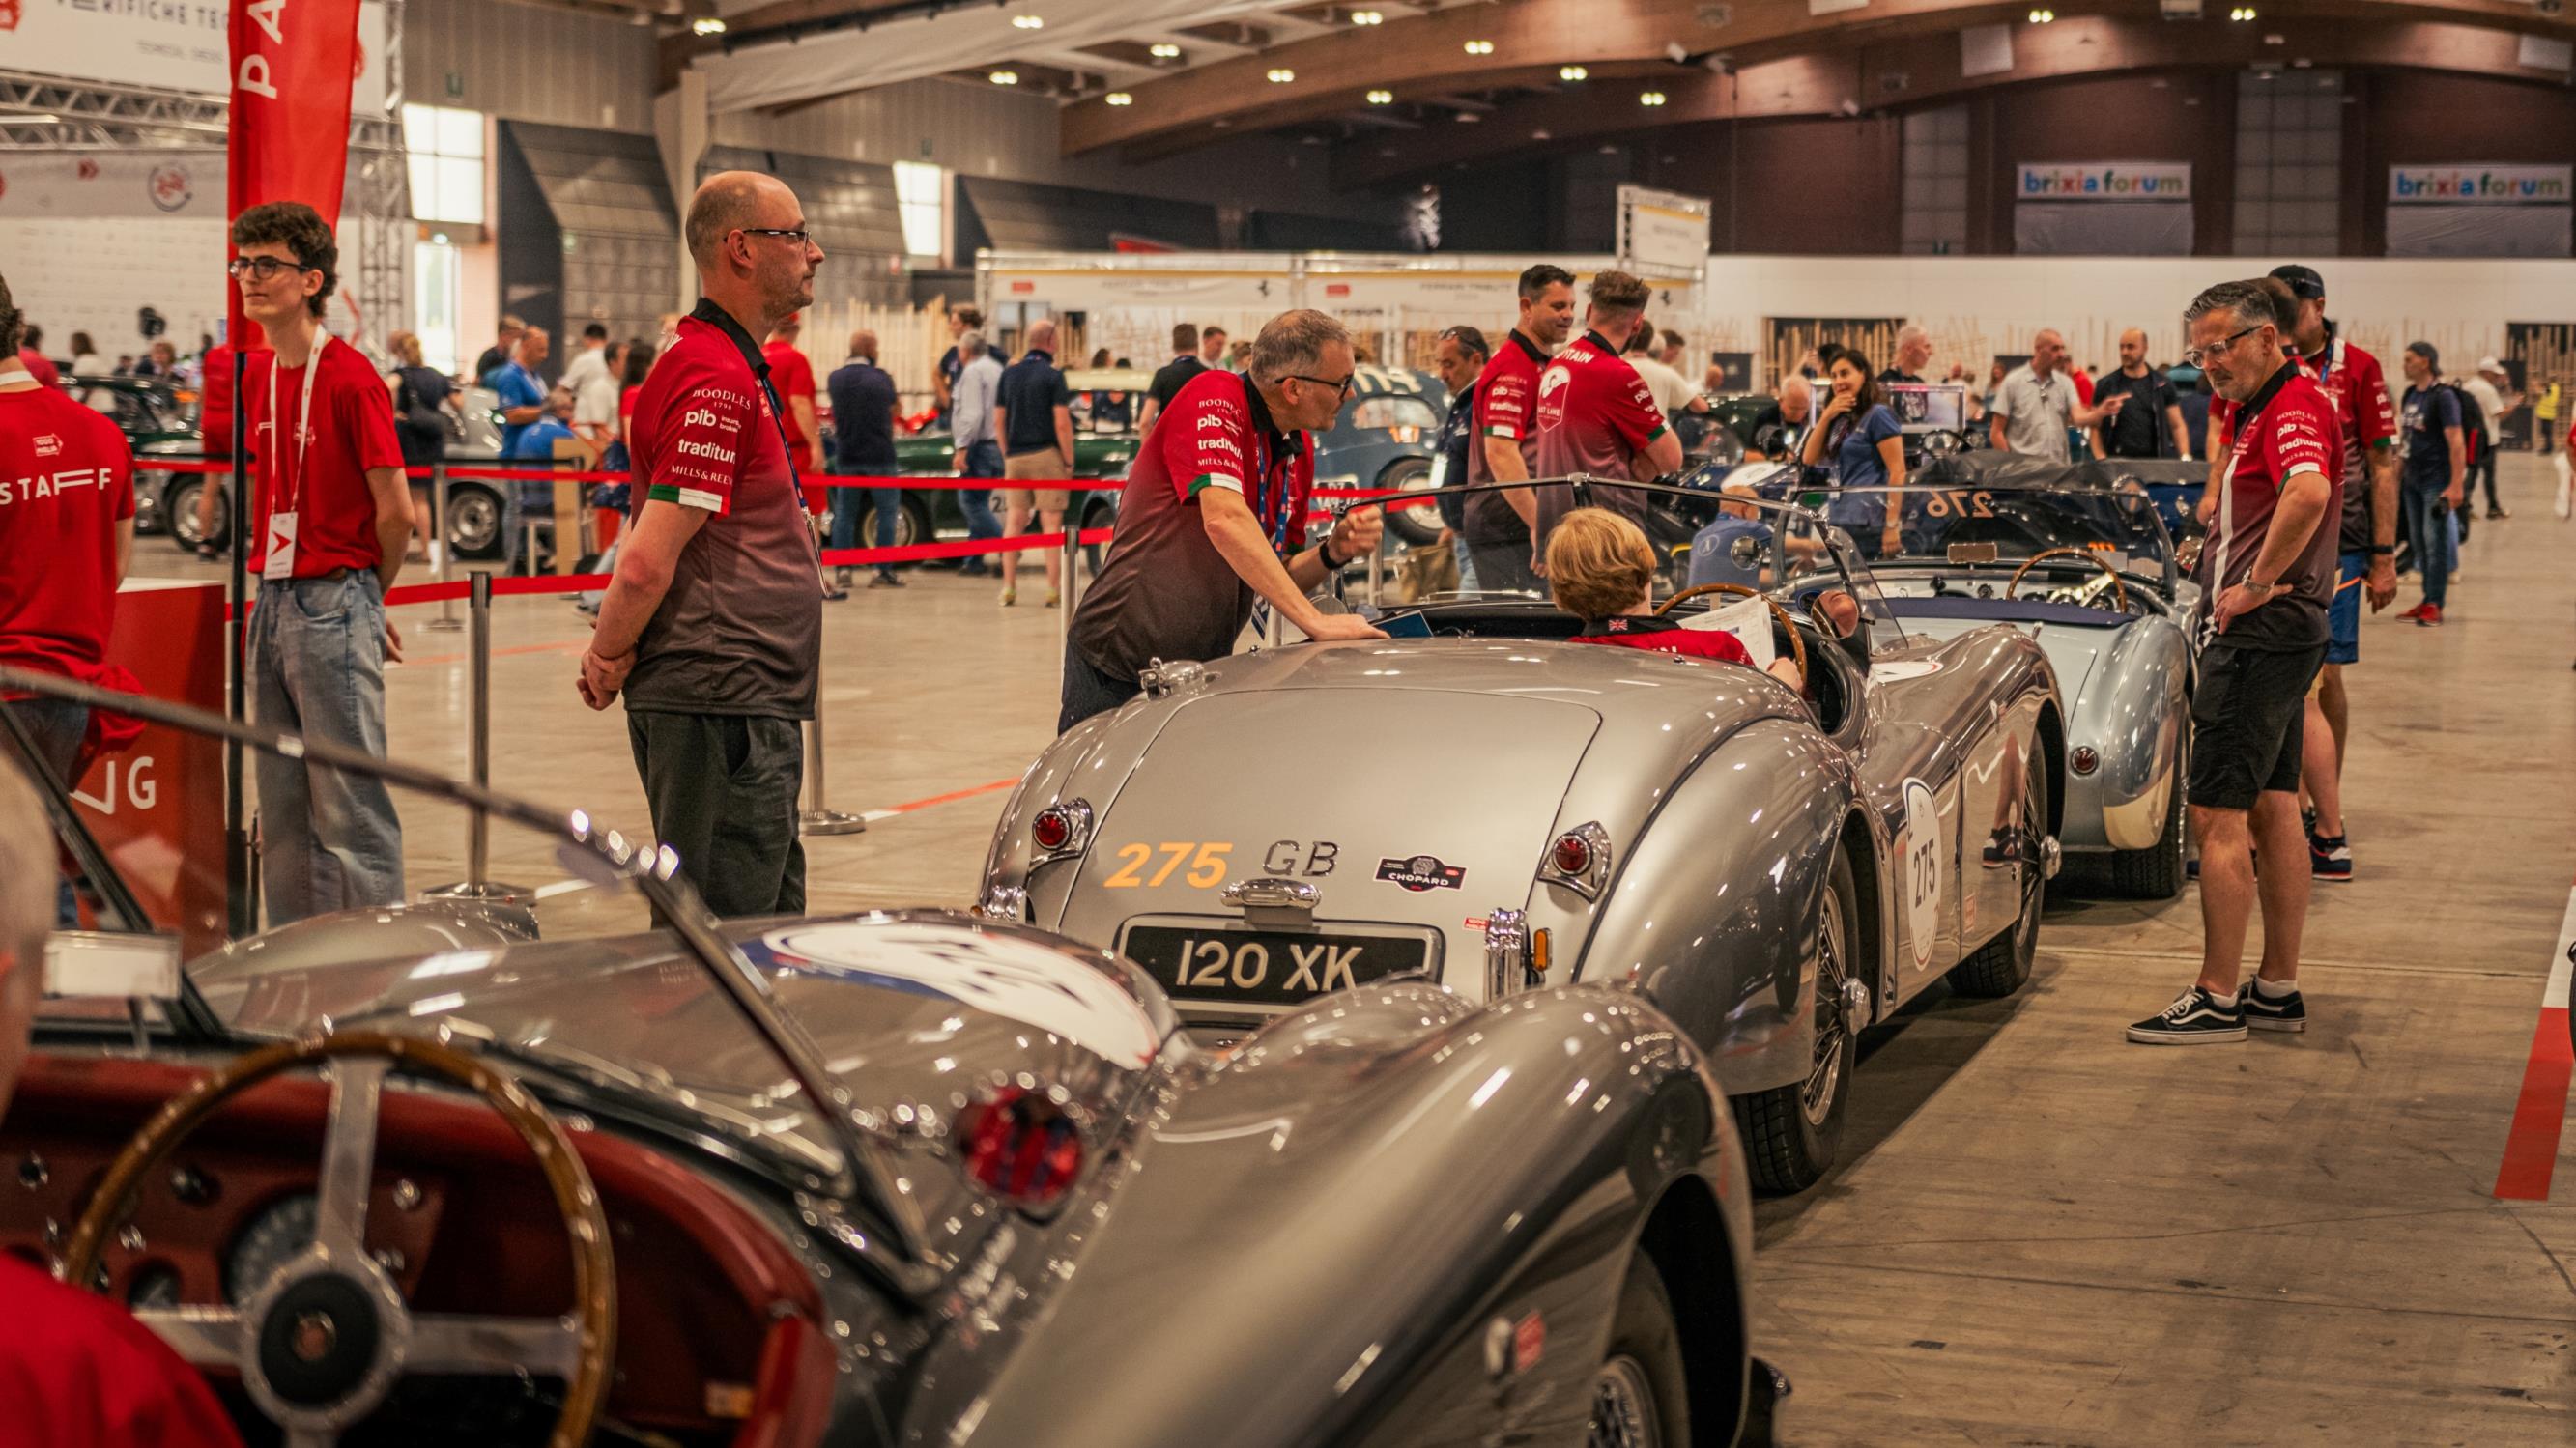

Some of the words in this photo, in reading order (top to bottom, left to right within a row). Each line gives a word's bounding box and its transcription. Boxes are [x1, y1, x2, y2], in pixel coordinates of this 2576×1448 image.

[2025, 170, 2099, 193] brixia
[2104, 170, 2183, 193] forum
[2397, 172, 2476, 195] brixia
[2480, 173, 2563, 195] forum
[684, 408, 717, 428] pib
[1197, 413, 1223, 432] pib
[2276, 423, 2297, 440] pib
[0, 468, 113, 505] STAFF
[1103, 841, 1234, 889] 275
[1262, 840, 1340, 877] GB
[1388, 871, 1450, 887] CHOPARD
[1913, 838, 1936, 909] 275
[1175, 939, 1269, 989] 120
[1282, 943, 1364, 993] XK
